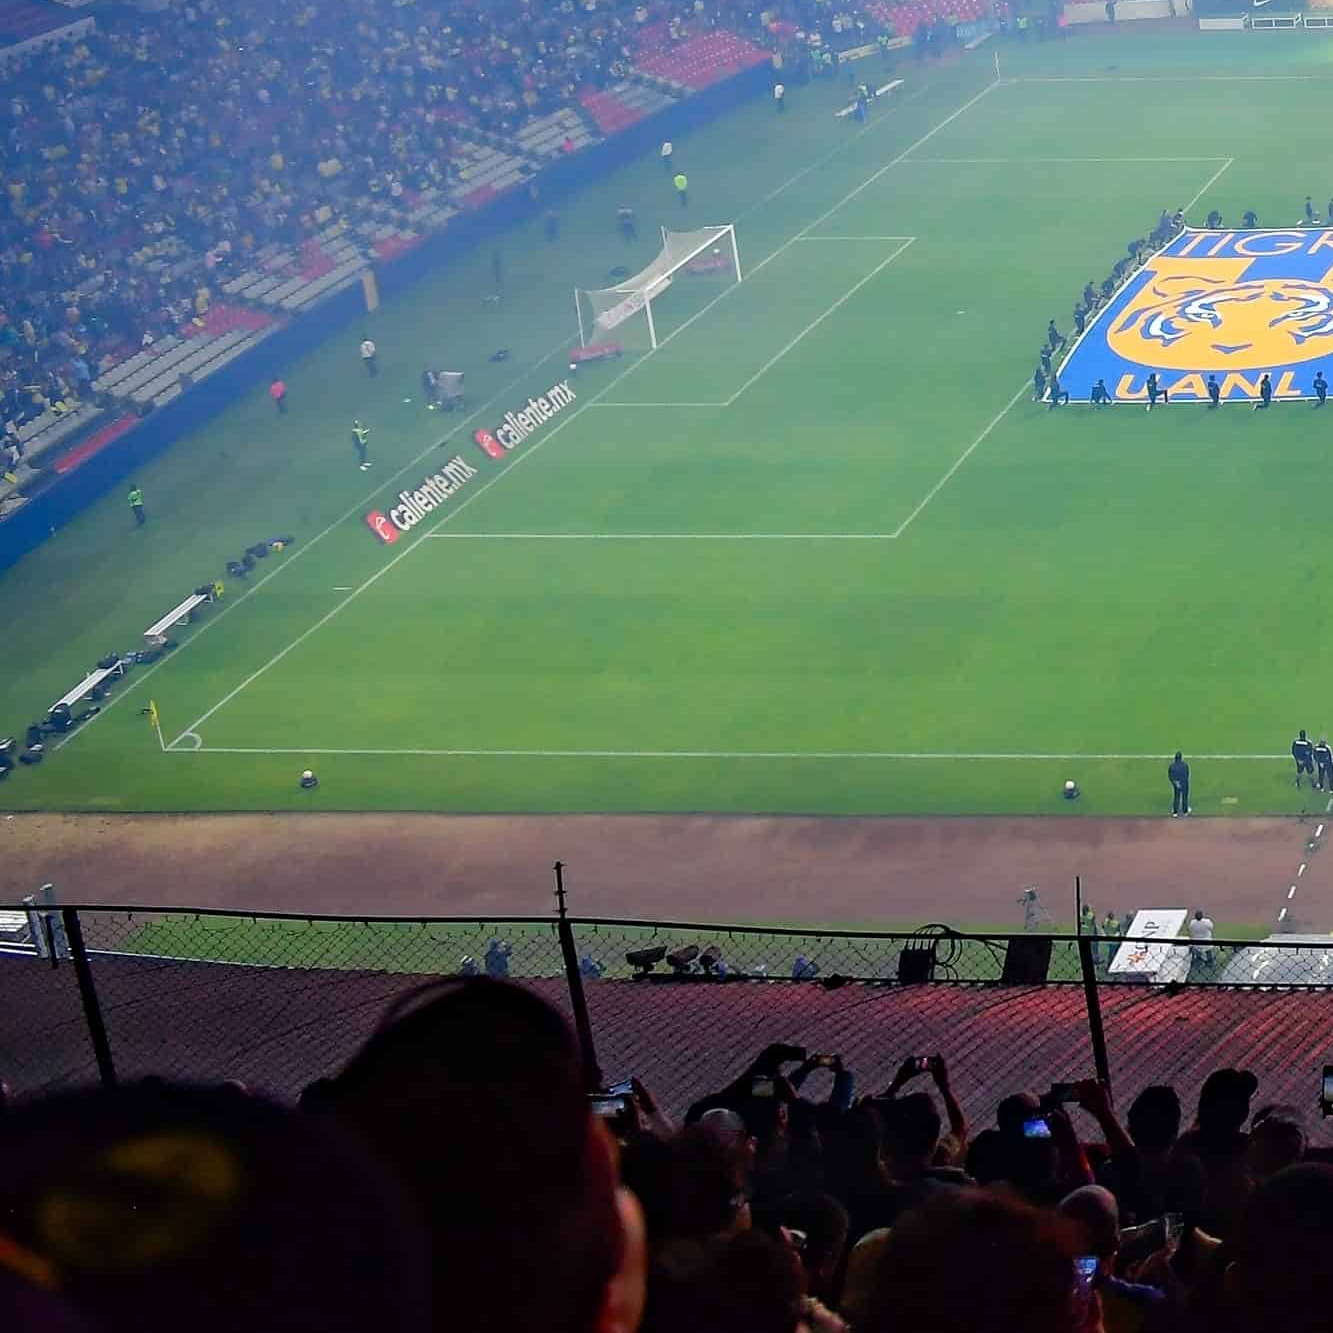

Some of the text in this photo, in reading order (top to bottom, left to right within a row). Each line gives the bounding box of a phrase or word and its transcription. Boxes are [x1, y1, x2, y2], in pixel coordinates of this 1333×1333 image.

[495, 378, 578, 450] caliente.mx
[1113, 370, 1304, 401] UANL
[388, 454, 479, 532] caliente.mx
